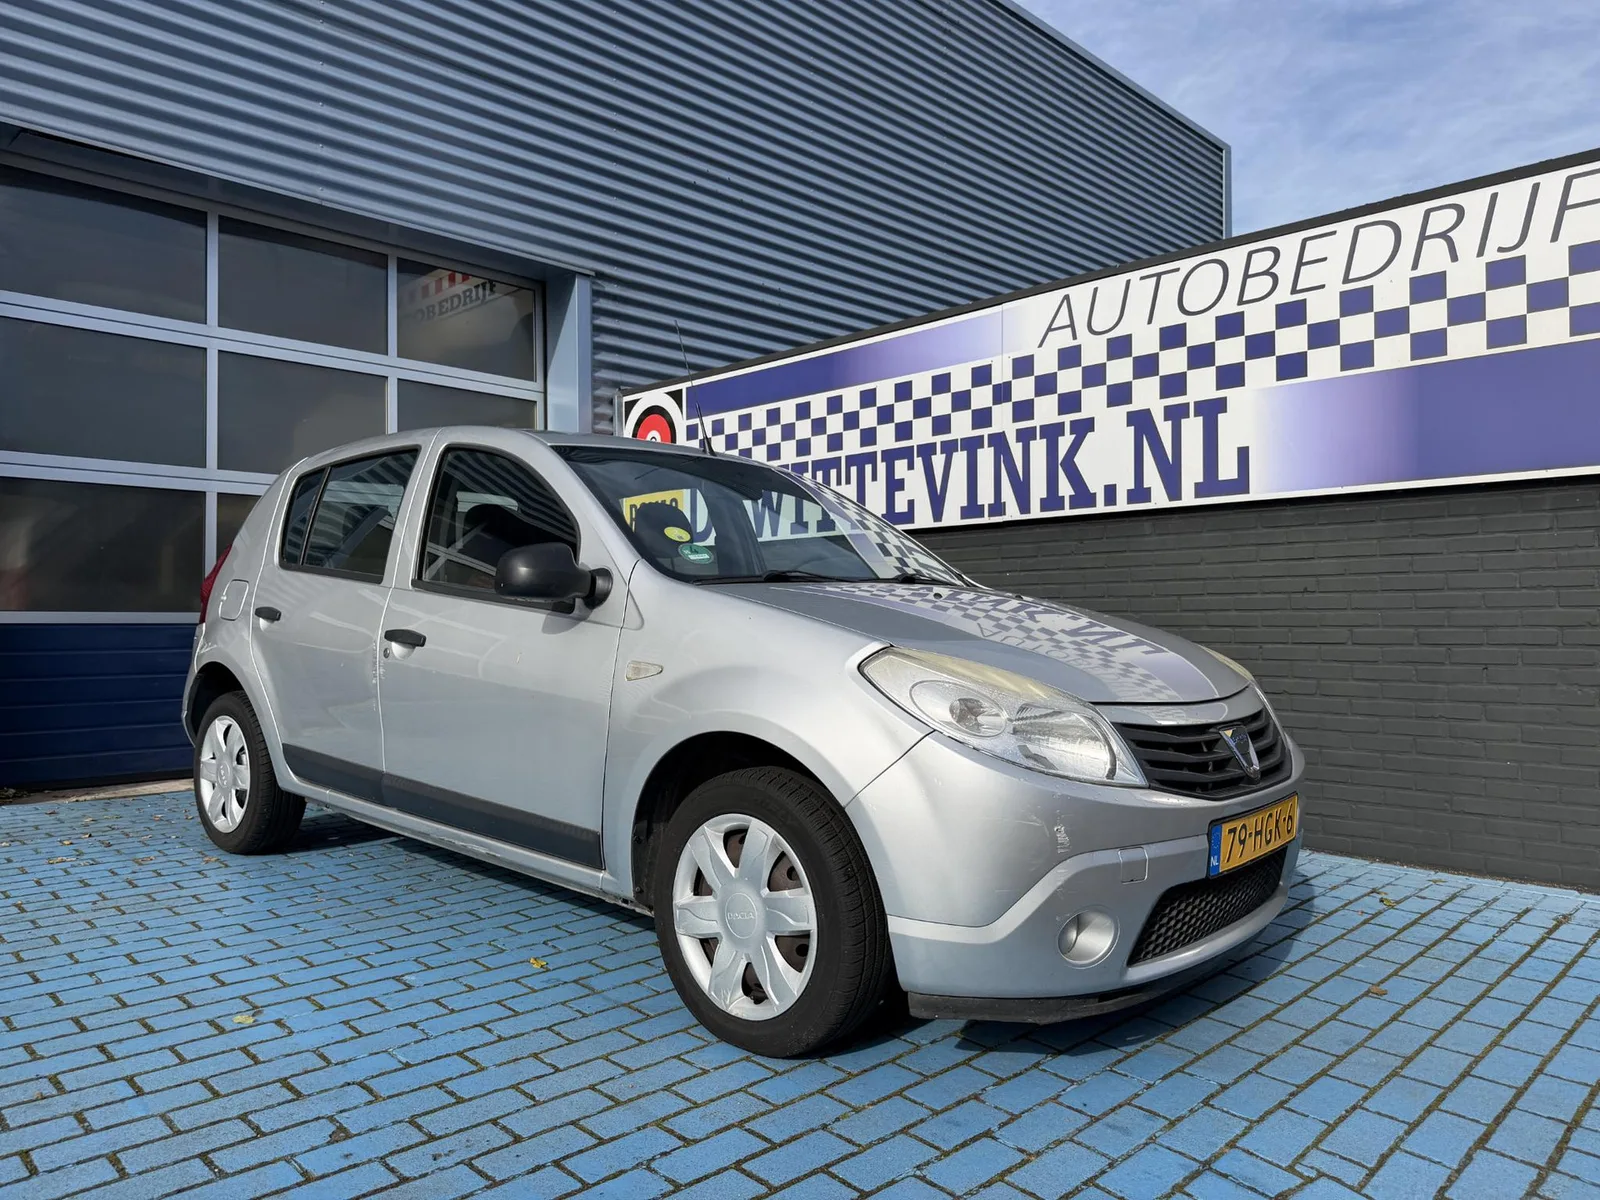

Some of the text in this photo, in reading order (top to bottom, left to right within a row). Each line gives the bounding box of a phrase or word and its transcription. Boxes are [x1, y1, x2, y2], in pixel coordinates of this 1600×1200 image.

[1037, 168, 1600, 348] AUTOBEDRIJF
[1210, 855, 1219, 867] NL
[1225, 803, 1293, 864] 79-HGK-6
